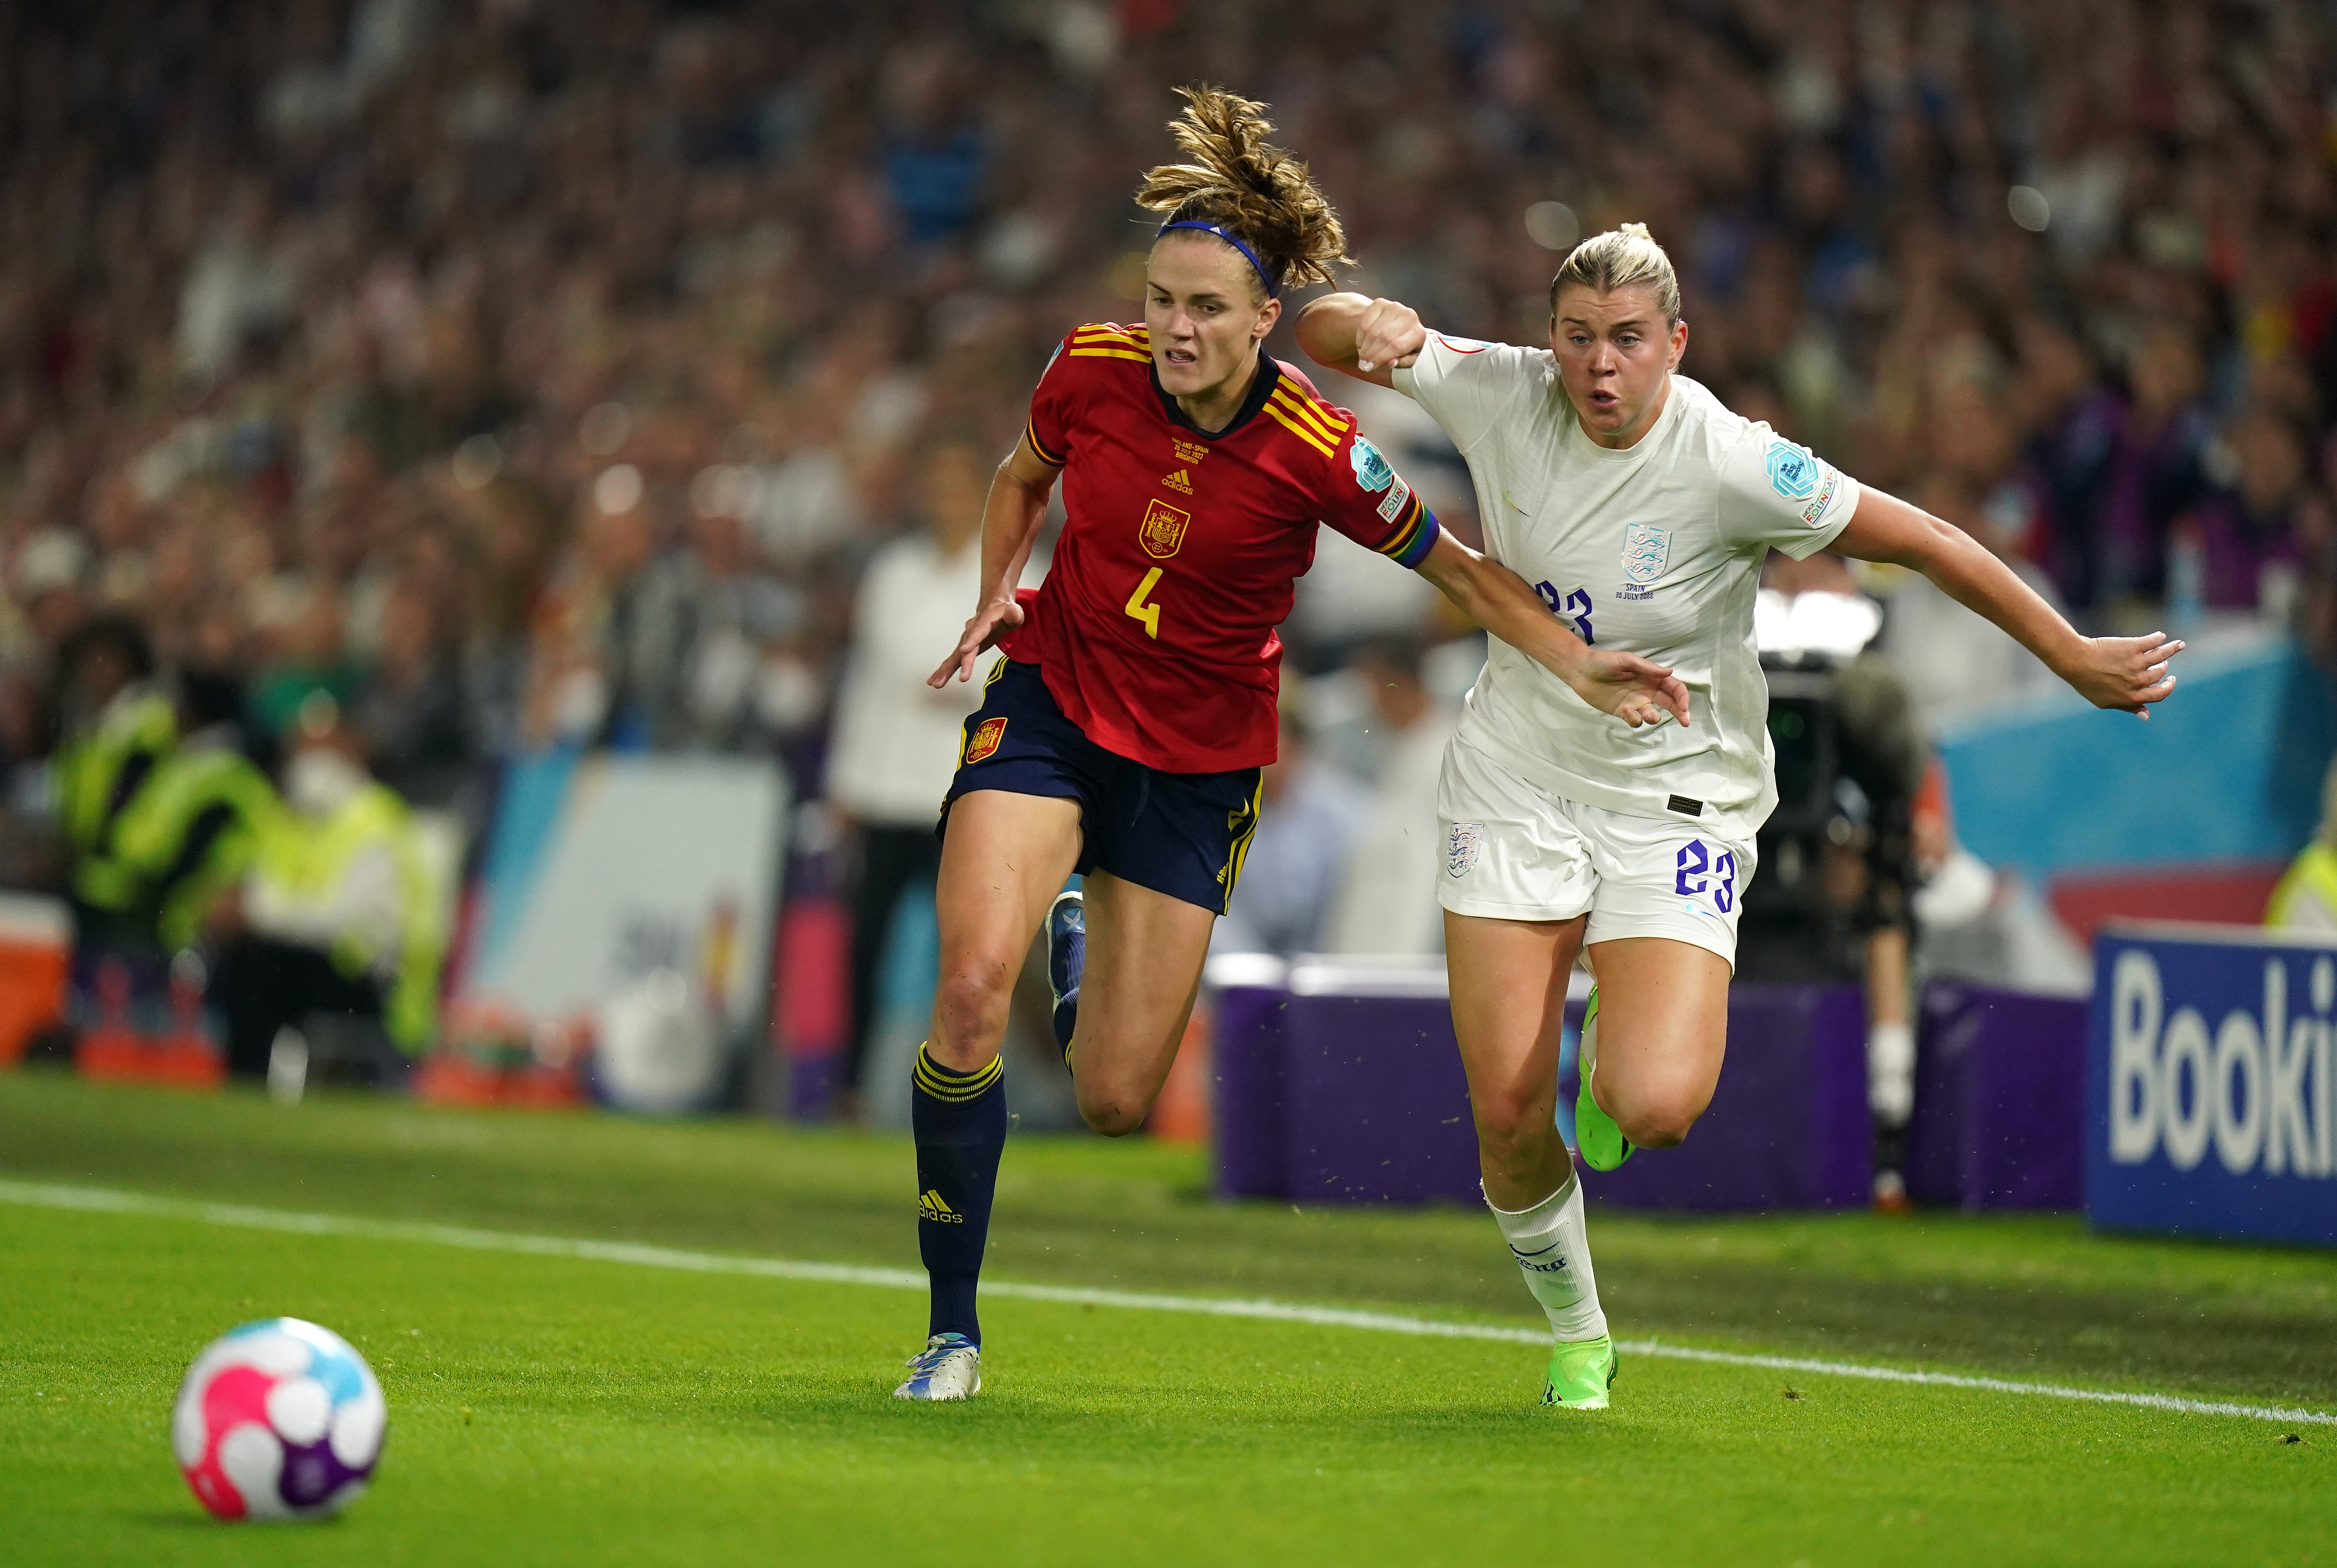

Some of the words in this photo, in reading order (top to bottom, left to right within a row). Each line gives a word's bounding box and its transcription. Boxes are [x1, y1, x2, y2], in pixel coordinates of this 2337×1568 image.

[1172, 437, 1209, 454] ENGLAND-SPAIN
[1175, 451, 1199, 465] BRIGHTON
[1191, 451, 1204, 460] 2022
[1162, 478, 1194, 495] adidas
[1625, 584, 1645, 592] SPAIN
[1125, 567, 1163, 640] 4
[1623, 592, 1638, 600] JULY
[1640, 592, 1654, 600] 2022
[1676, 839, 1735, 914] 23
